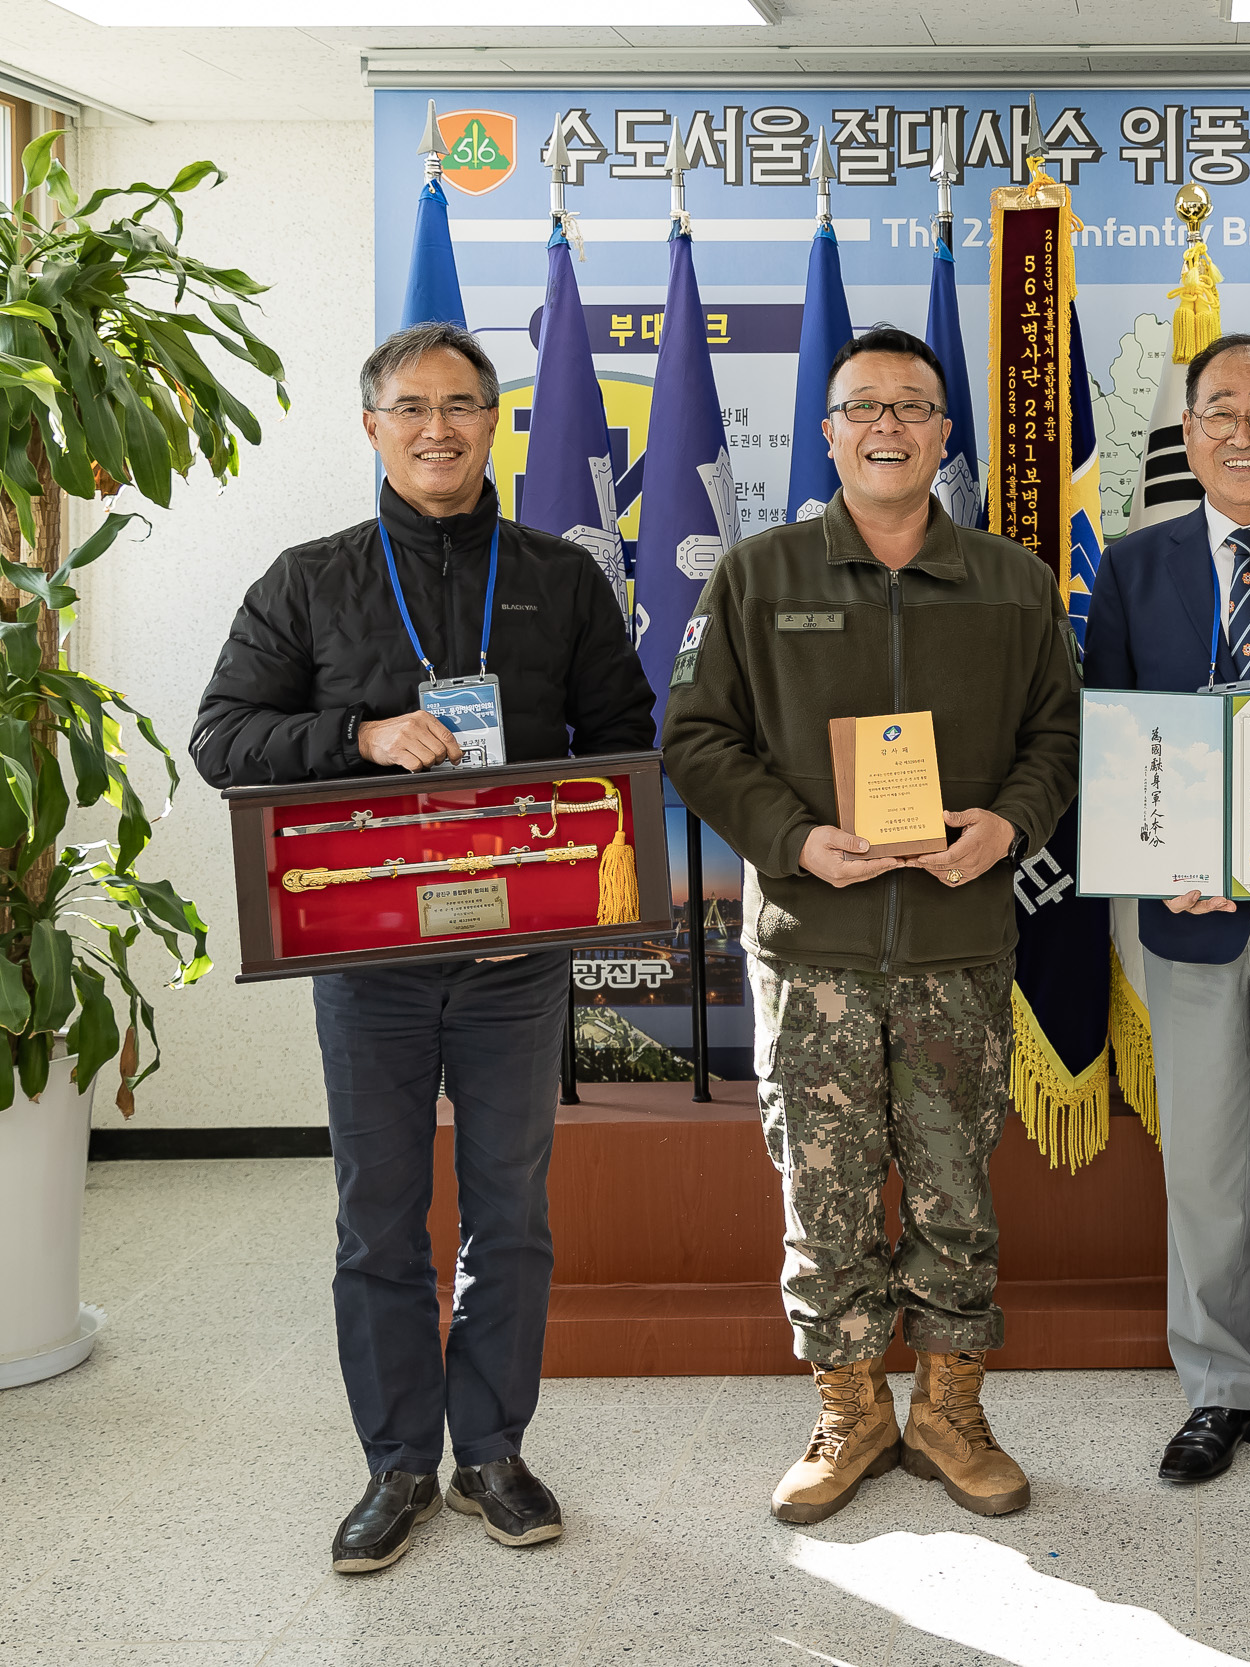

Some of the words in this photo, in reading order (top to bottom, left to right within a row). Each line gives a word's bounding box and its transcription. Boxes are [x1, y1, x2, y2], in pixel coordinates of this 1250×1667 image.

[453, 137, 497, 163] 56
[540, 106, 812, 187] 수도서울
[831, 105, 1107, 186] 절대사수
[882, 218, 931, 248] Th
[609, 313, 732, 347] 부대크
[729, 434, 762, 448] 도권의
[769, 434, 790, 448] 평화
[735, 482, 765, 501] 란색
[741, 508, 751, 522] 한
[501, 603, 538, 611] BLACKYAK
[574, 961, 672, 989] 광진구
